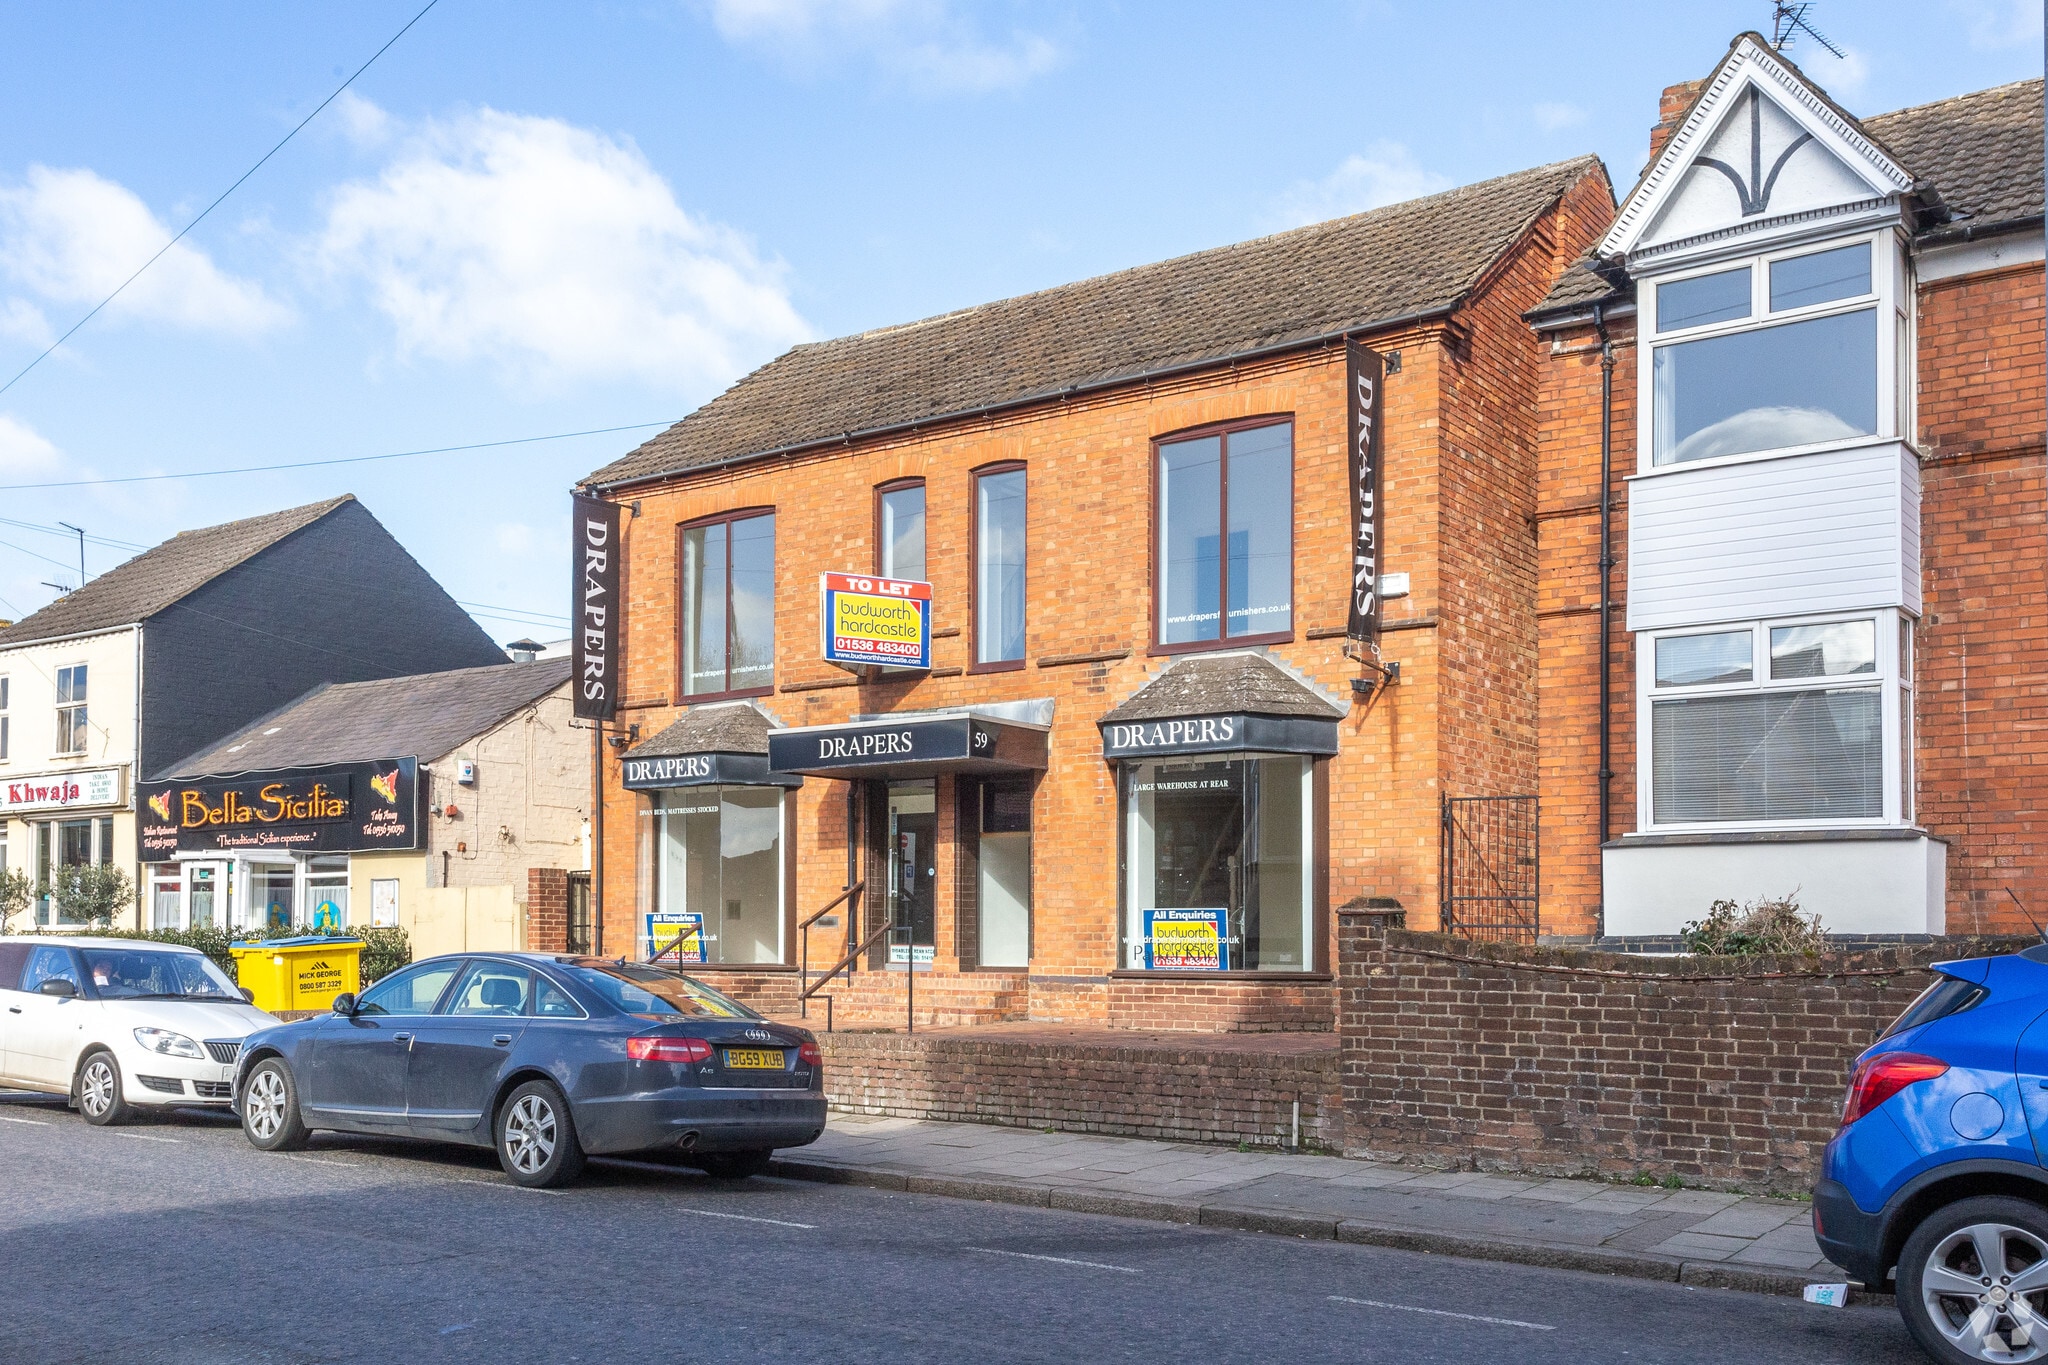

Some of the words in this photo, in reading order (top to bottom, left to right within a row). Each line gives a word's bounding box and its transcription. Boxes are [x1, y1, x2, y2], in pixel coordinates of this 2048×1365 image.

[1356, 369, 1376, 616] DRAPERS
[846, 578, 872, 591] TO
[879, 582, 912, 596] LET
[583, 517, 608, 700] DRAPERS
[841, 599, 910, 620] budworth
[841, 616, 917, 637] hardcastle
[837, 638, 874, 650] 01536
[877, 643, 919, 655] 483400
[835, 652, 921, 664] www.budworthhardcastle.com
[690, 662, 774, 678] www.drapersurnishers.co.uk
[974, 732, 988, 748] 59
[1111, 716, 1234, 749] DRAPERS
[819, 731, 913, 759] DRAPERS
[628, 756, 710, 782] DRAPERS
[8, 780, 80, 805] Khwaja
[1134, 783, 1156, 792] LARGE
[1157, 781, 1198, 790] WAREHOUSE
[1199, 780, 1209, 788] AT
[1210, 779, 1229, 788] REAR
[180, 791, 250, 828] Bella
[255, 783, 343, 823] Sicilia
[668, 806, 697, 814] MATTRESSES
[663, 915, 696, 923] Enquiries
[1153, 911, 1166, 919] All
[1168, 911, 1216, 921] Enquiries
[1156, 922, 1209, 938] budworth
[300, 982, 314, 990] 0800
[315, 981, 326, 989] 587
[730, 1052, 760, 1065] BG59
[762, 1053, 783, 1066] XUB
